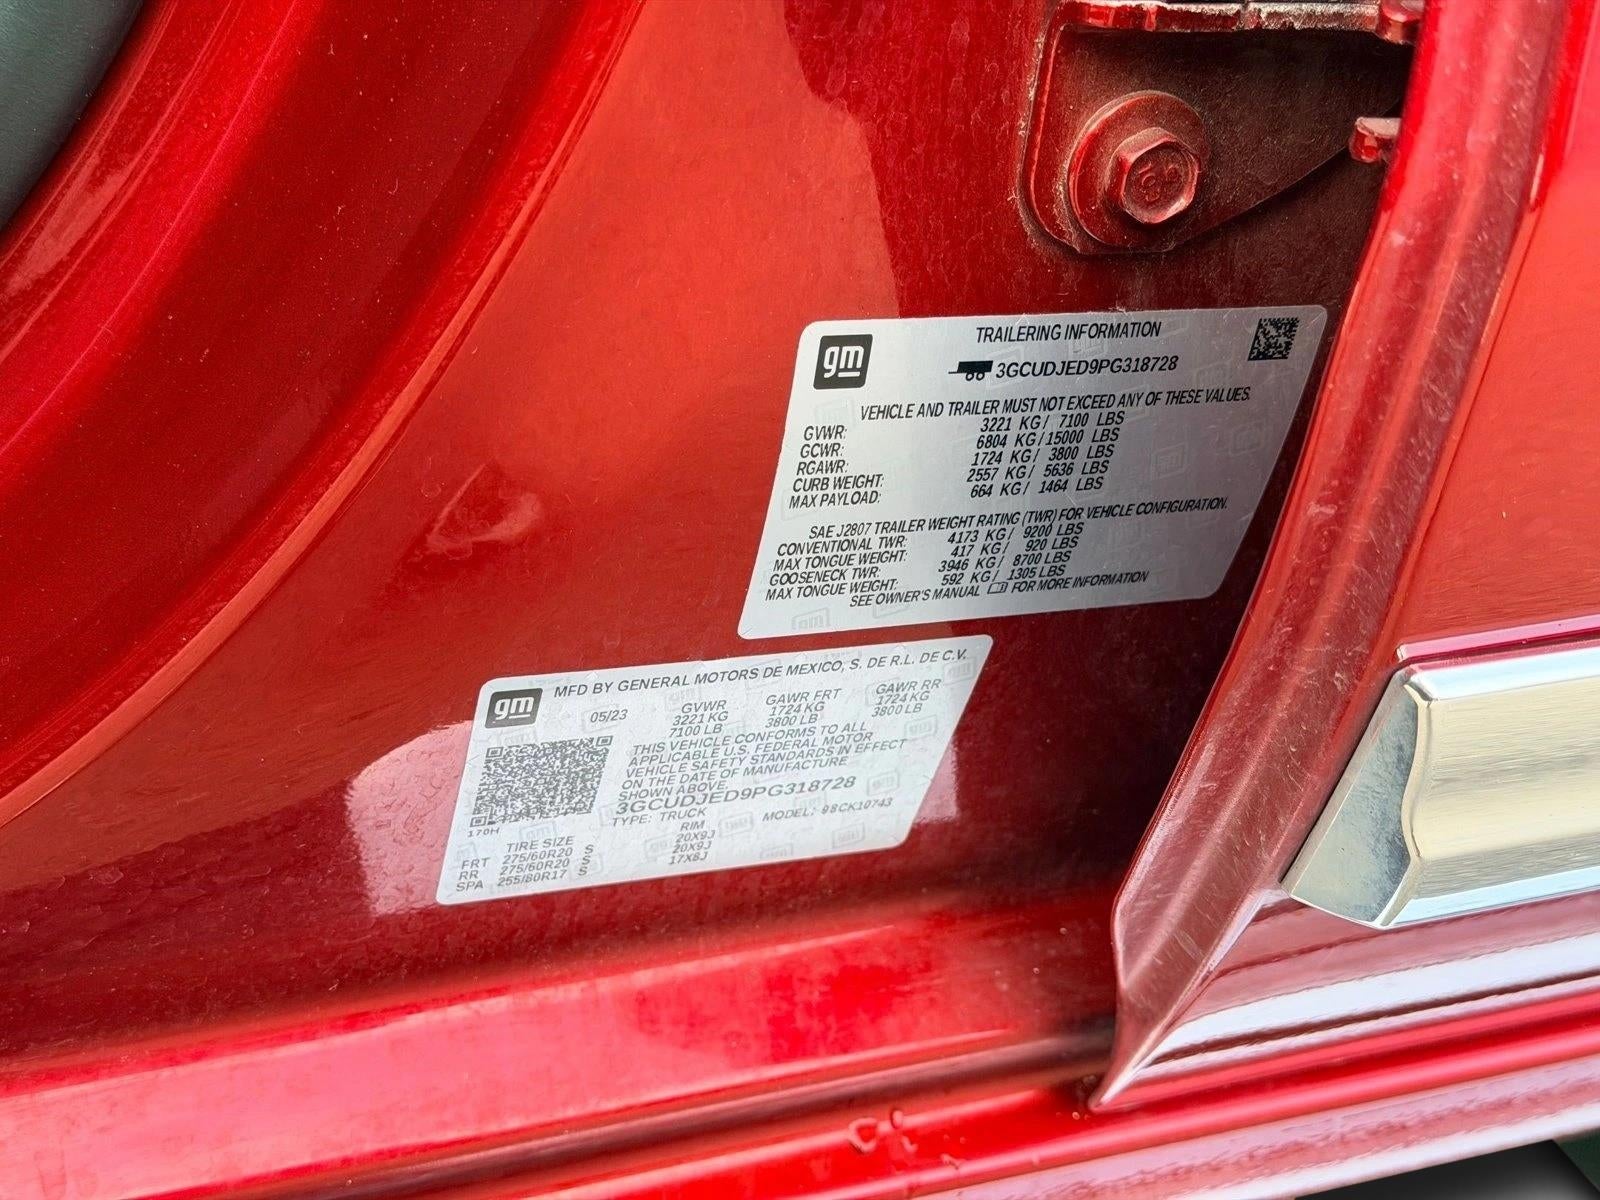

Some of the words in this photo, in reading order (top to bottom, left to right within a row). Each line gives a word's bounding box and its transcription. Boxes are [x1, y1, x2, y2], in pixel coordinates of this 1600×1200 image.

[977, 324, 1061, 343] TRAILERING
[1064, 321, 1161, 340] INFORMATION
[823, 345, 865, 379] gm
[996, 356, 1178, 378] 3GCUDJED9PG318728
[861, 404, 915, 420] VEHICLE
[917, 402, 944, 417] AND
[949, 400, 1000, 416] TRAILER
[1002, 398, 1037, 413] MUST
[1039, 396, 1066, 411] NOT
[1067, 394, 1115, 410] EXCEED
[1117, 393, 1144, 407] ANY
[1145, 392, 1162, 406] OF
[1166, 389, 1203, 405] THESE
[1206, 387, 1250, 402] VALUES.
[804, 425, 847, 441] GVWR:
[980, 417, 1012, 432] 3221
[1059, 413, 1089, 428] 7100
[1097, 411, 1125, 426] LBS
[800, 443, 844, 458] GCWR:
[977, 434, 1008, 449] 6804
[1092, 428, 1120, 443] LBS
[796, 460, 848, 475] RGAWR:
[971, 451, 1003, 466] 1724
[1049, 446, 1079, 461] 3800
[1087, 444, 1114, 459] LBS
[793, 477, 830, 492] CURB
[833, 474, 884, 490] WEIGHT:
[967, 468, 999, 482] 2557
[1044, 462, 1074, 477] 5636
[1081, 460, 1109, 475] LBS
[789, 494, 818, 508] MAX
[820, 490, 881, 507] PAYLOAD:
[971, 484, 993, 498] 664
[1038, 479, 1069, 493] 1464
[1076, 477, 1104, 491] LBS
[809, 525, 835, 539] SAE
[836, 522, 872, 537] J2807
[875, 519, 926, 534] TRAILER
[928, 515, 976, 530] WEIGHT
[976, 512, 1020, 527] RATING
[1022, 509, 1057, 527] (TWR)
[1058, 508, 1084, 521] FOR
[1087, 504, 1135, 518] VEHICLE
[1136, 498, 1227, 515] CONFIGURATION.
[773, 558, 802, 571] MAX
[805, 554, 856, 569] TONGUE
[859, 550, 907, 565] WEIGHT:
[951, 544, 974, 557] 417
[1025, 539, 1047, 552] 920
[1052, 537, 1079, 549] LBS
[777, 538, 872, 556] CONVENTIONAL
[879, 535, 907, 549] TWR:
[948, 530, 979, 544] 4173
[1023, 524, 1052, 538] 9200
[1057, 522, 1084, 536] LBS
[766, 587, 793, 600] MAX
[797, 583, 847, 598] TONGUE
[850, 579, 898, 594] WEIGHT:
[941, 573, 964, 586] 592
[1007, 567, 1037, 580] 1305
[1039, 565, 1066, 578] LBS
[770, 569, 848, 586] GOOSENECK
[852, 566, 881, 579] TWR:
[938, 558, 969, 572] 3946
[1013, 553, 1042, 566] 8700
[1044, 551, 1071, 564] LBS
[850, 591, 876, 607] SEE
[876, 589, 931, 605] OWNER'S
[932, 584, 979, 599] MANUAL
[1011, 580, 1036, 593] FOR
[1037, 577, 1073, 590] MORE
[1072, 571, 1149, 588] INFORMATION
[554, 684, 588, 697] MFD
[592, 682, 613, 694] BY
[618, 675, 689, 691] GENERAL
[694, 668, 759, 685] MOTORS
[763, 666, 783, 678] DE
[786, 660, 844, 676] MEXICO,
[849, 659, 861, 670] S.
[867, 656, 887, 668] DE
[890, 654, 914, 666] R.L.
[920, 651, 940, 663] DE
[942, 649, 967, 661] C.V.
[876, 681, 918, 694] GAWR
[921, 679, 941, 691] RR
[493, 696, 535, 721] gm
[681, 700, 727, 713] GVWR
[766, 692, 810, 705] GAWR
[814, 688, 842, 701] FRT
[769, 704, 802, 716] 1724
[804, 701, 825, 713] KG
[871, 705, 903, 717] 3800
[905, 703, 923, 713] LB
[875, 694, 908, 707] 1724
[909, 692, 930, 704] KG
[590, 709, 628, 723] 05/23
[669, 725, 701, 738] 7100
[704, 723, 723, 734] LB
[673, 714, 704, 726] 3221
[708, 711, 728, 723] KG
[765, 715, 797, 728] 3800
[800, 714, 818, 725] LB
[628, 748, 720, 767] APPLICABLE
[724, 745, 749, 756] U.S.
[755, 738, 818, 753] FEDERAL
[822, 732, 873, 746] MOTOR
[631, 742, 666, 756] THIS
[670, 735, 731, 751] VEHICLE
[735, 726, 816, 744] CONFORMS
[821, 724, 838, 735] TO
[841, 722, 866, 733] ALL
[622, 779, 643, 790] ON
[649, 775, 676, 787] THE
[679, 770, 717, 784] DATE
[720, 768, 739, 779] OF
[743, 756, 848, 776] MANUFACTURE
[626, 762, 688, 778] VEHICLE
[691, 756, 747, 771] SAFETY
[750, 746, 835, 765] STANDARDS
[837, 744, 852, 755] IN
[855, 739, 907, 753] EFFECT
[616, 776, 856, 814] 3GCUDJED9PG318728
[618, 787, 673, 801] SHOWN
[676, 780, 728, 795] ABOVE.
[612, 814, 652, 827] TYPE:
[660, 807, 707, 821] TRUCK
[680, 820, 705, 831] RIM
[762, 807, 816, 821] MODEL:
[461, 857, 490, 870] FRT
[502, 847, 573, 864] 275/60R20
[585, 844, 594, 854] S
[676, 830, 715, 845] 20X9J
[507, 840, 538, 853] TIRE
[543, 836, 574, 848] SIZE
[458, 870, 478, 881] RR
[500, 857, 570, 876] 275/60R20
[582, 855, 591, 865] S
[672, 841, 712, 854] 20X9J
[456, 880, 483, 892] SPA
[578, 866, 587, 876] S
